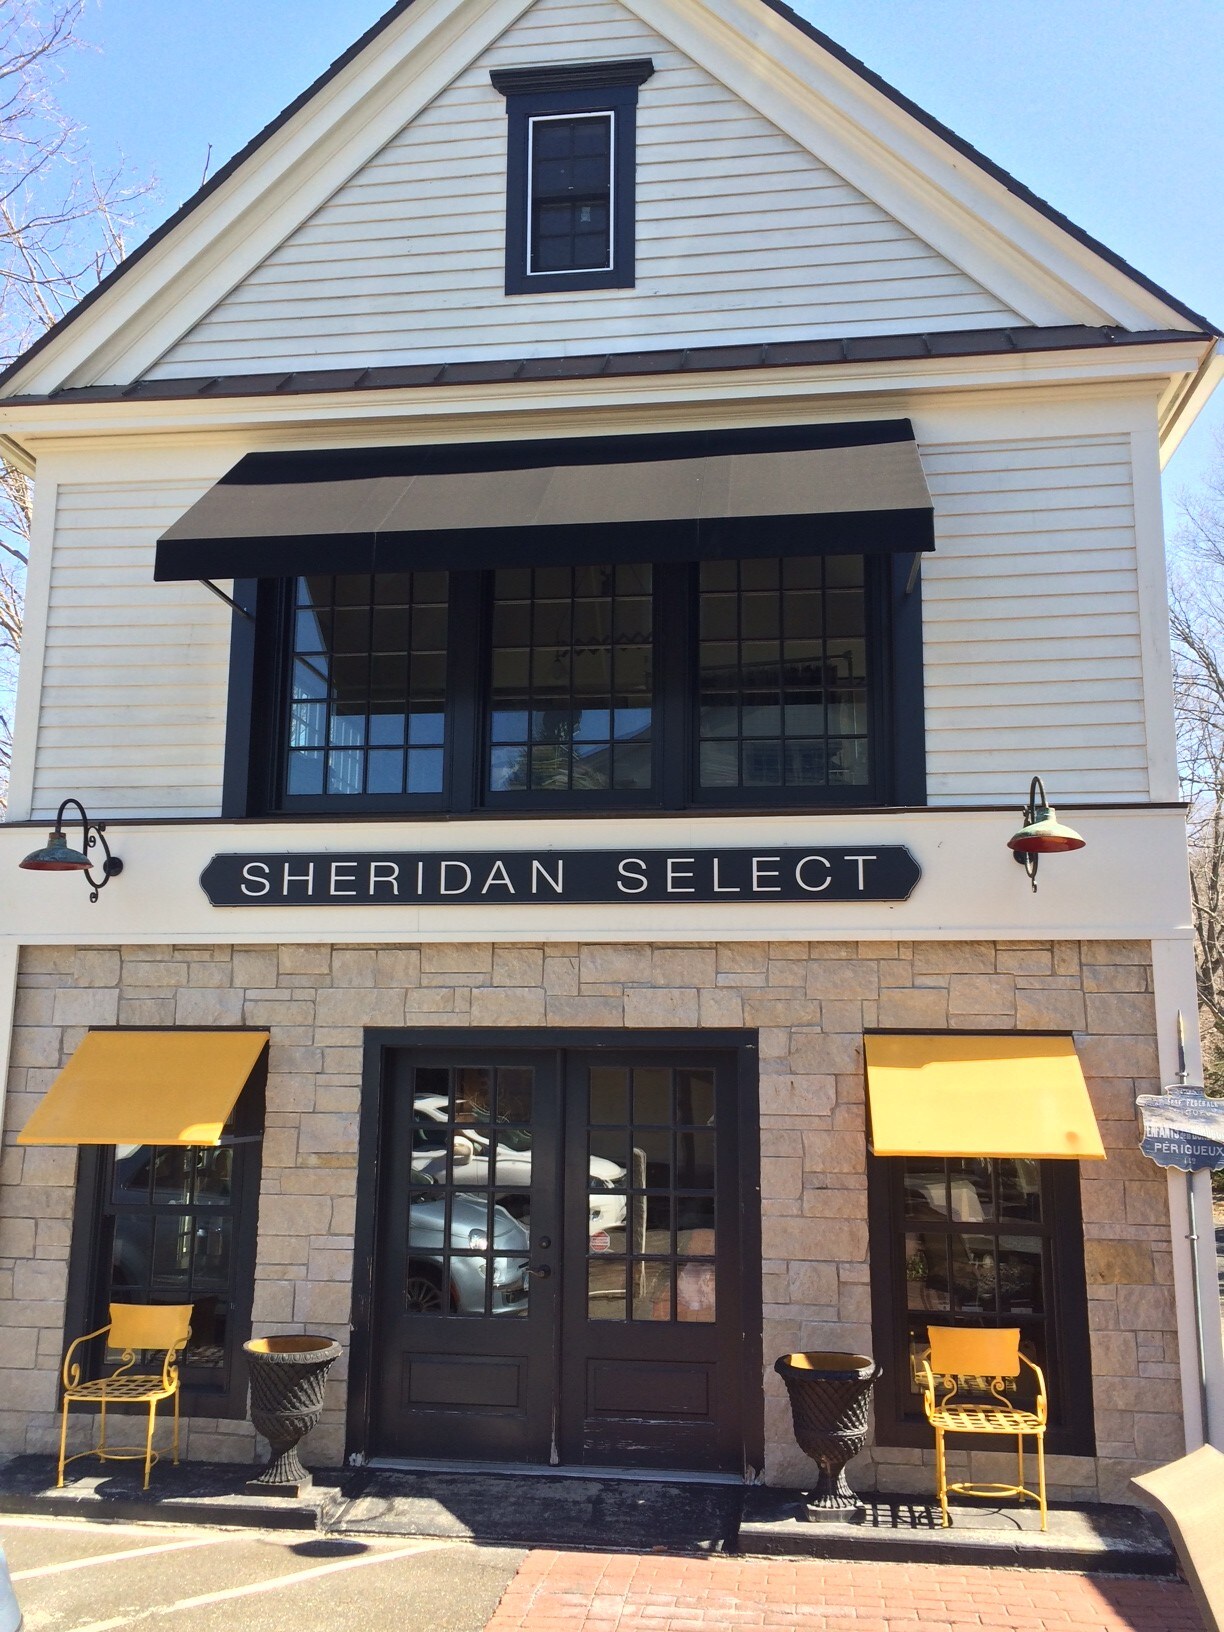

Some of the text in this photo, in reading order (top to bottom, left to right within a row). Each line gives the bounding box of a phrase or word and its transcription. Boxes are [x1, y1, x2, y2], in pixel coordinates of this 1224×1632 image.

[240, 855, 877, 896] SHERIDAN SELECT
[1154, 1141, 1224, 1156] PÉRIGUEUX
